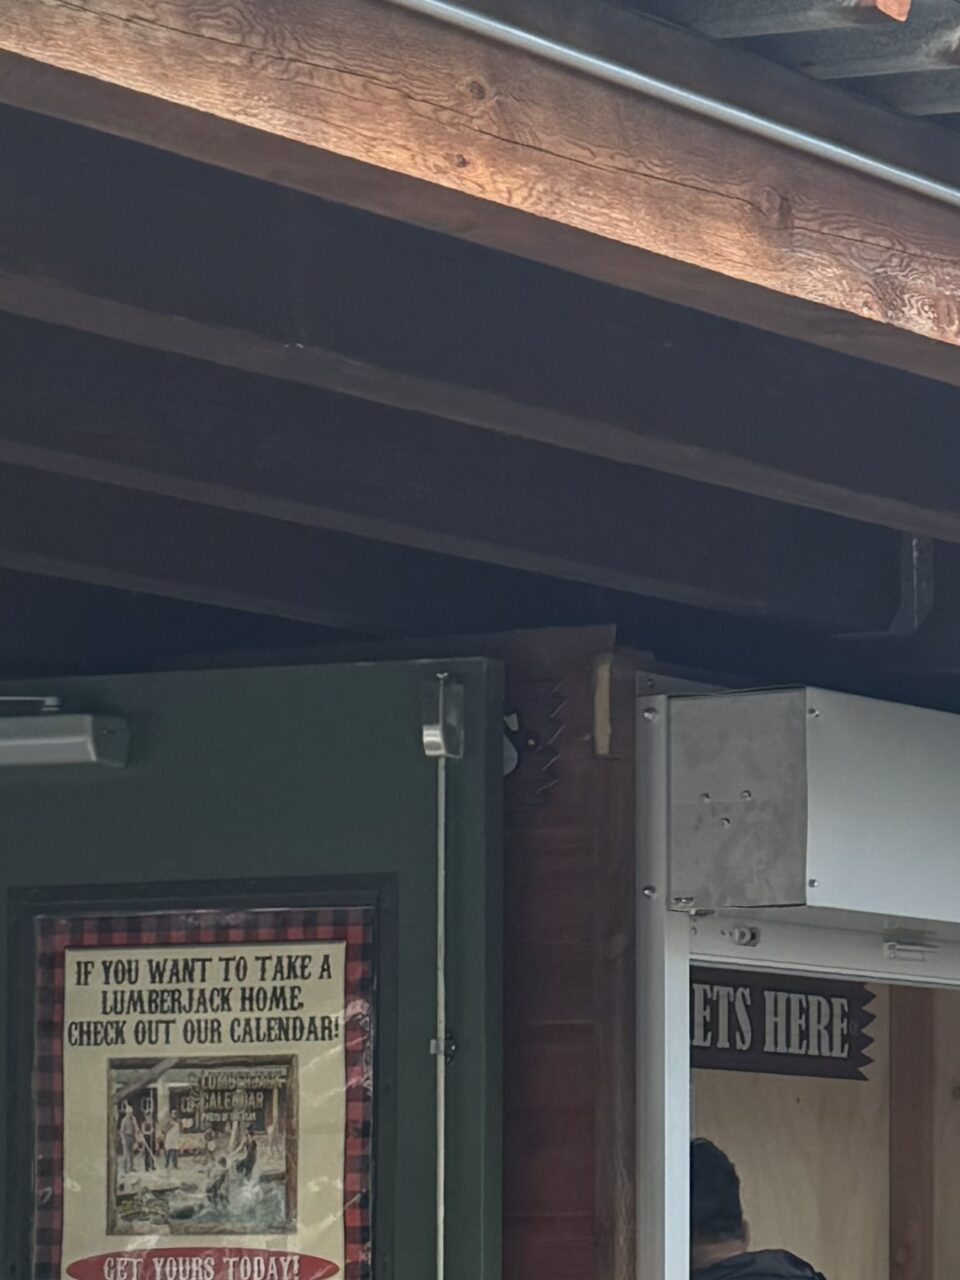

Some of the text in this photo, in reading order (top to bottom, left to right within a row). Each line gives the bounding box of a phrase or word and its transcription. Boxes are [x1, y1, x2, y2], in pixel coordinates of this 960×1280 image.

[75, 954, 332, 986] IF YOU WANT TO TAKE A
[101, 987, 232, 1015] LUMBERJACK
[68, 1015, 339, 1046] CHECK OUT OUR CALENDAR!
[763, 990, 849, 1058] HERE
